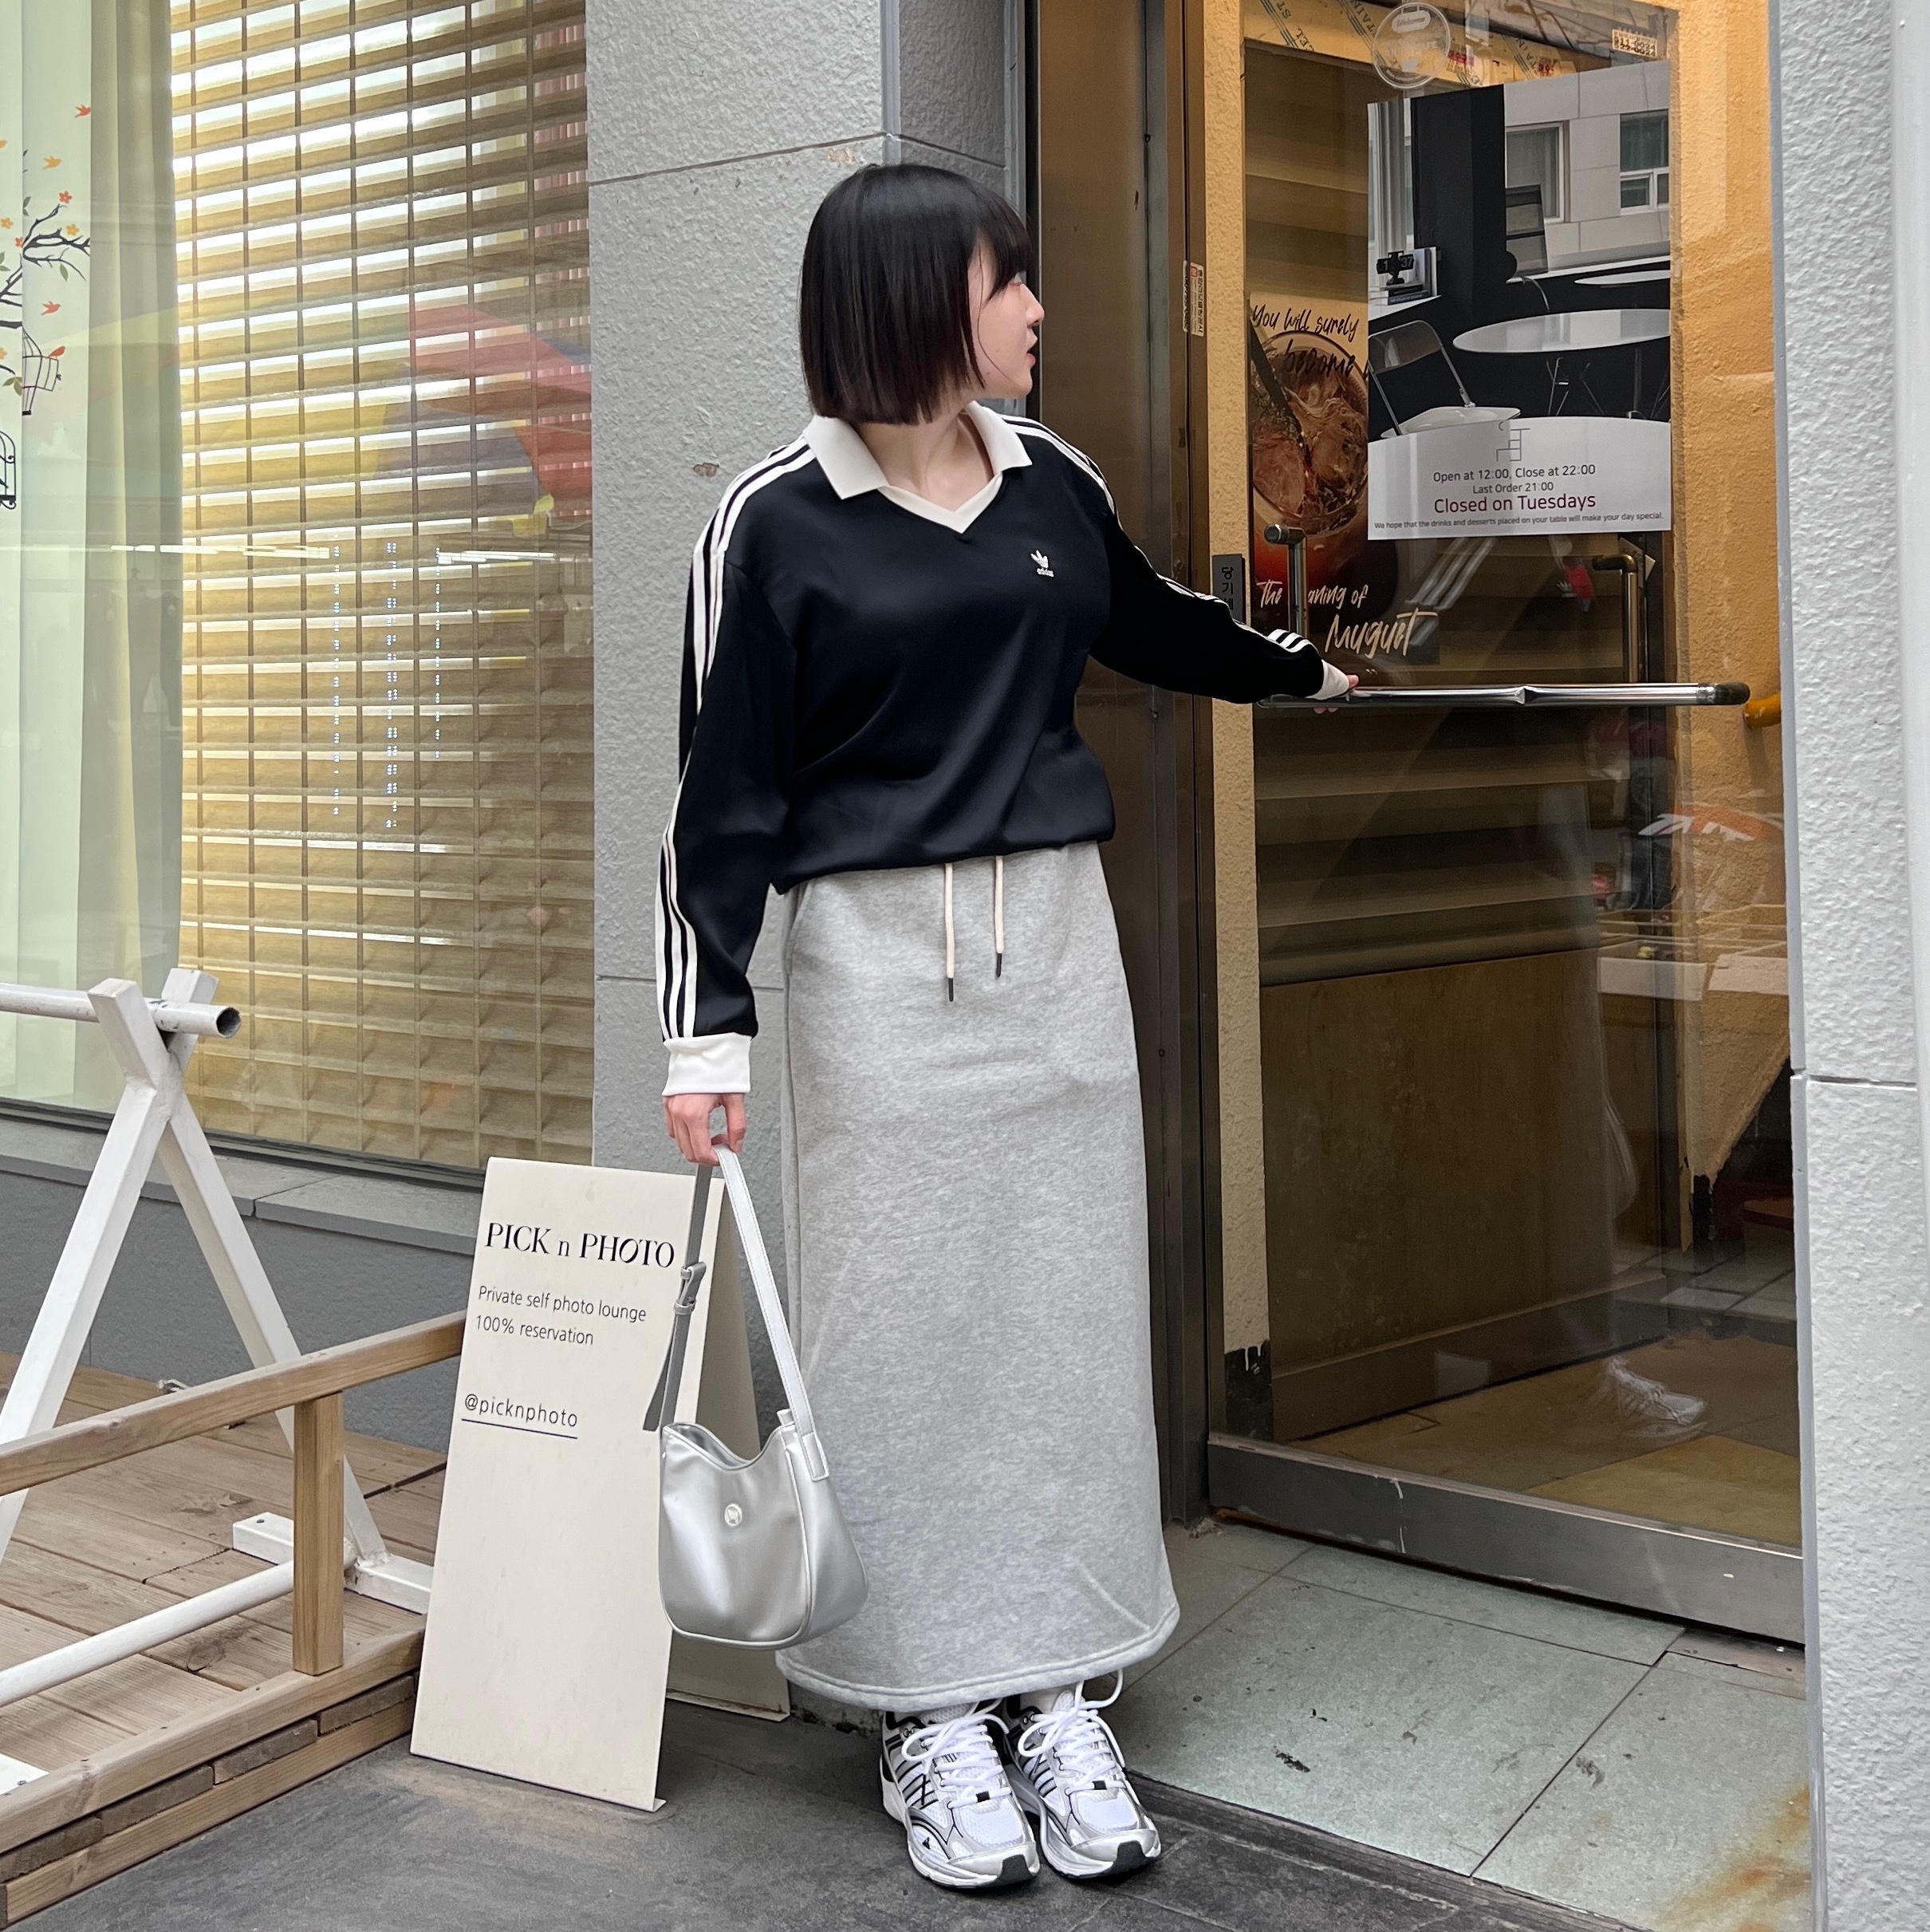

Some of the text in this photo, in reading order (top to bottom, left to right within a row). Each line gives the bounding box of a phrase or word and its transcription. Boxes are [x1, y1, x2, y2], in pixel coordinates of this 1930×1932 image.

[1252, 304, 1281, 329] You
[1314, 313, 1360, 343] surely
[1283, 338, 1356, 378] become
[1433, 464, 1596, 484] Open at 12:00, Close at 22:00
[1473, 482, 1554, 495] Last Order 21:00
[1434, 493, 1596, 514] Closed on Tuesdays
[1497, 517, 1520, 526] placed
[1603, 514, 1620, 522] your
[1636, 511, 1664, 520] special.
[1222, 566, 1235, 611] 당기세
[1256, 578, 1369, 609] The aning of
[1324, 607, 1438, 660] Muguet
[485, 1222, 675, 1268] PICK n PHOTO
[479, 1285, 647, 1323] Private self photo lounge
[476, 1315, 594, 1345] 100% reservation
[464, 1393, 578, 1427] @picknphoto
